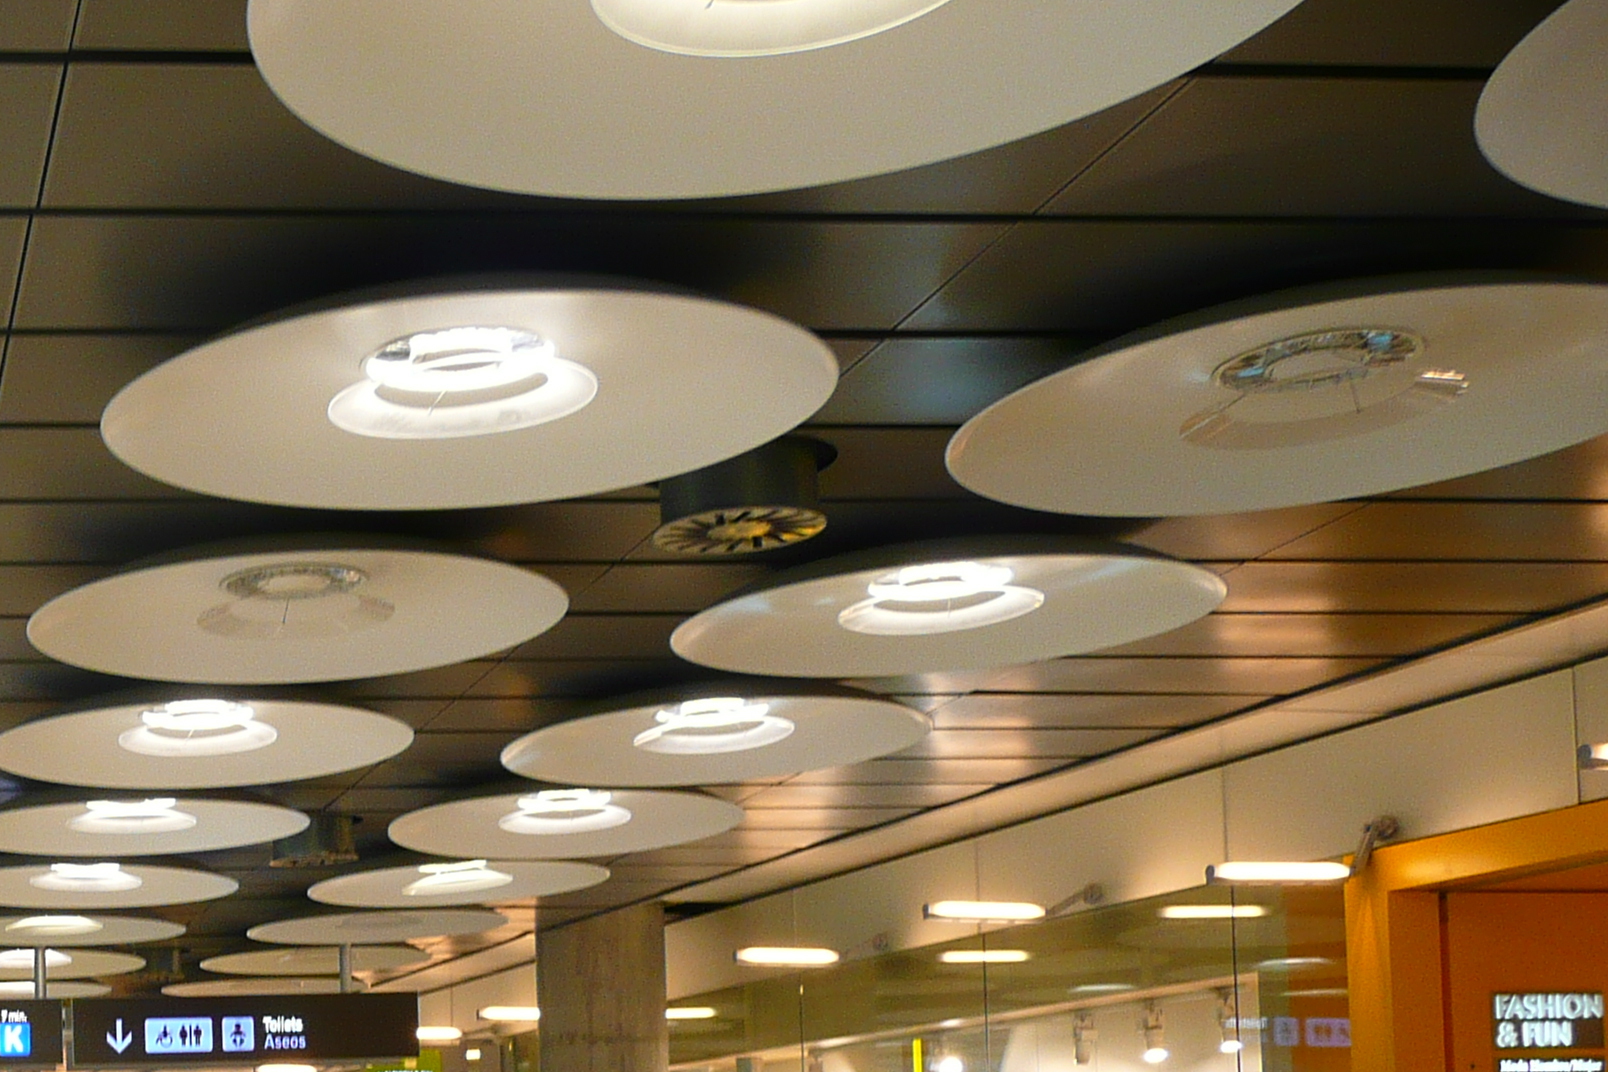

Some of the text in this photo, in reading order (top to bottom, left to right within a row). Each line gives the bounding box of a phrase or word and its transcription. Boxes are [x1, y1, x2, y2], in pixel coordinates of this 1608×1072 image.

[1494, 993, 1605, 1020] FASHION
[262, 1014, 304, 1033] Toilets
[1495, 1020, 1573, 1048] & FUN
[4, 1024, 24, 1053] K
[264, 1033, 306, 1050] Aseos
